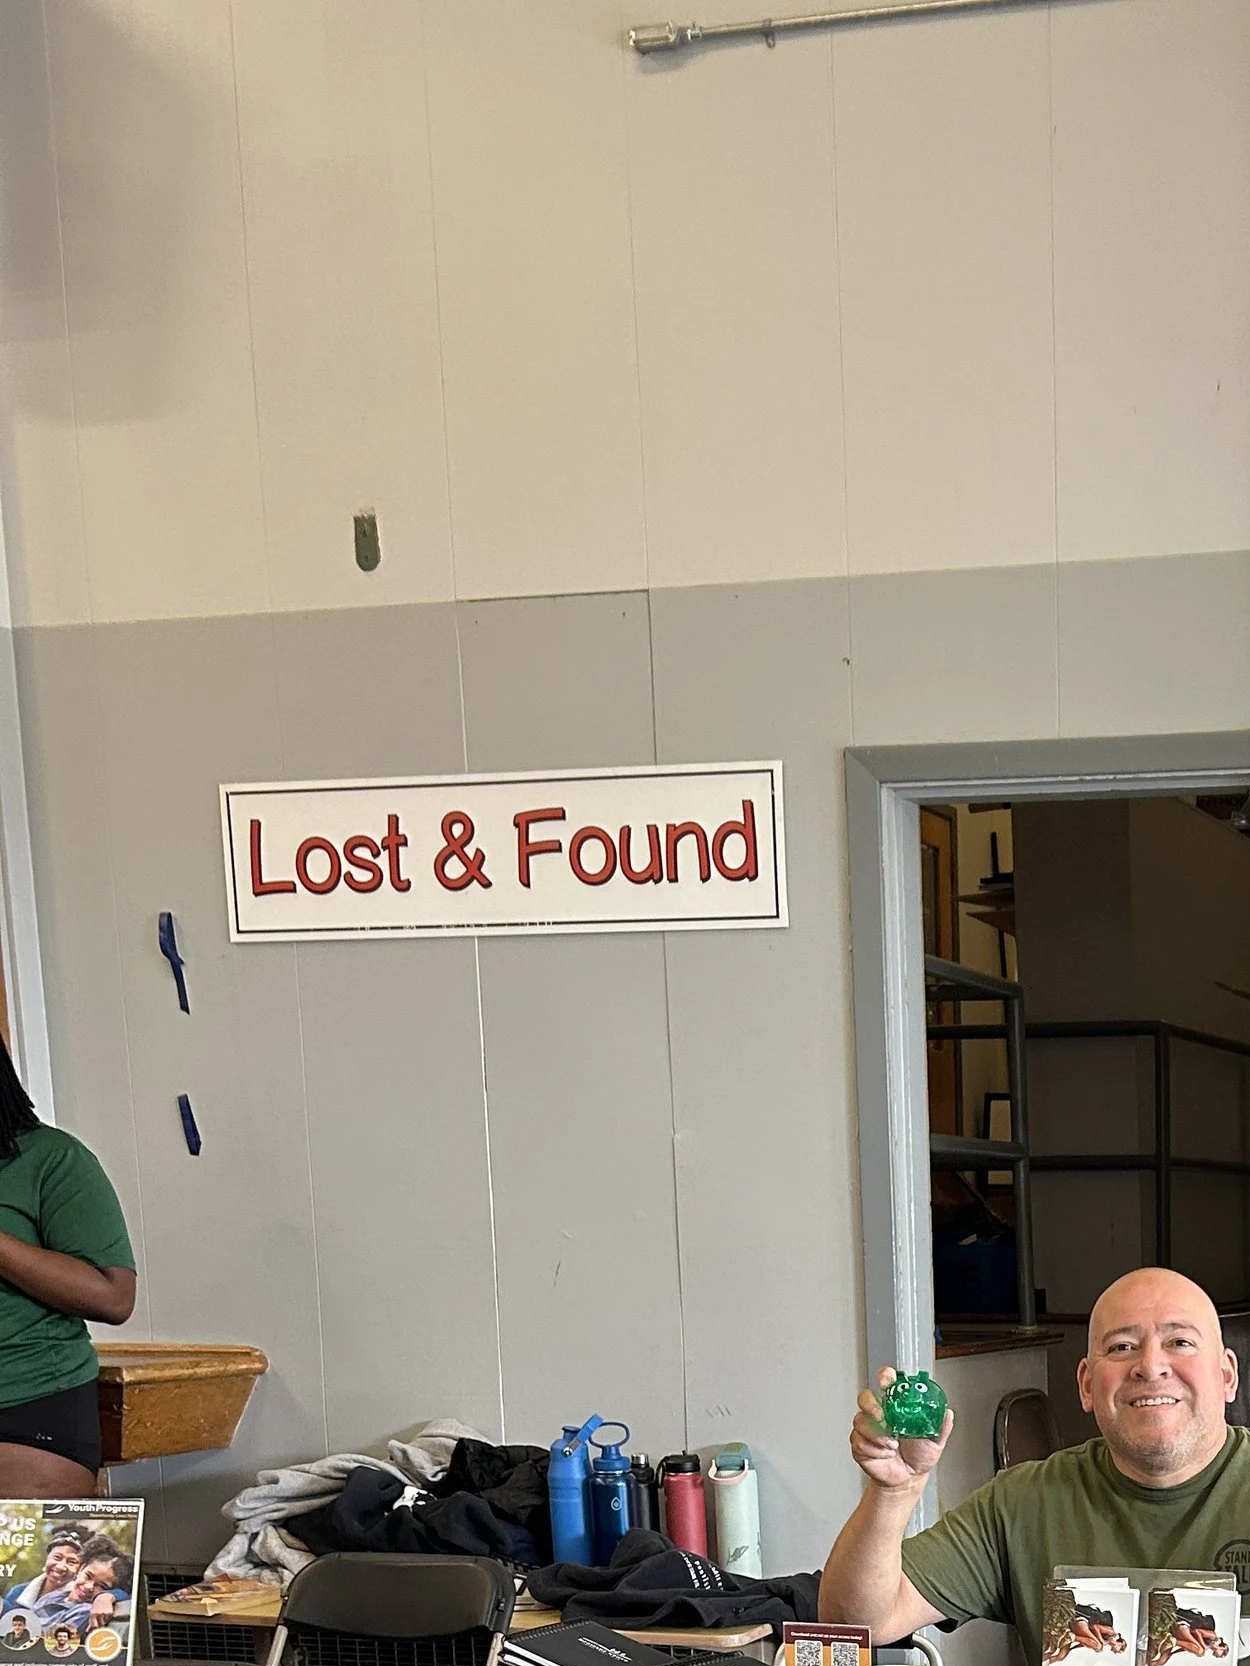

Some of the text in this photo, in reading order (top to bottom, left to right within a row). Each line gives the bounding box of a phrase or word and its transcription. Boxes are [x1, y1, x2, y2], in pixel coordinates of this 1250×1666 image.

[250, 799, 759, 897] Lost & Found
[68, 1504, 138, 1514] Youth Progress
[12, 1518, 37, 1531] US
